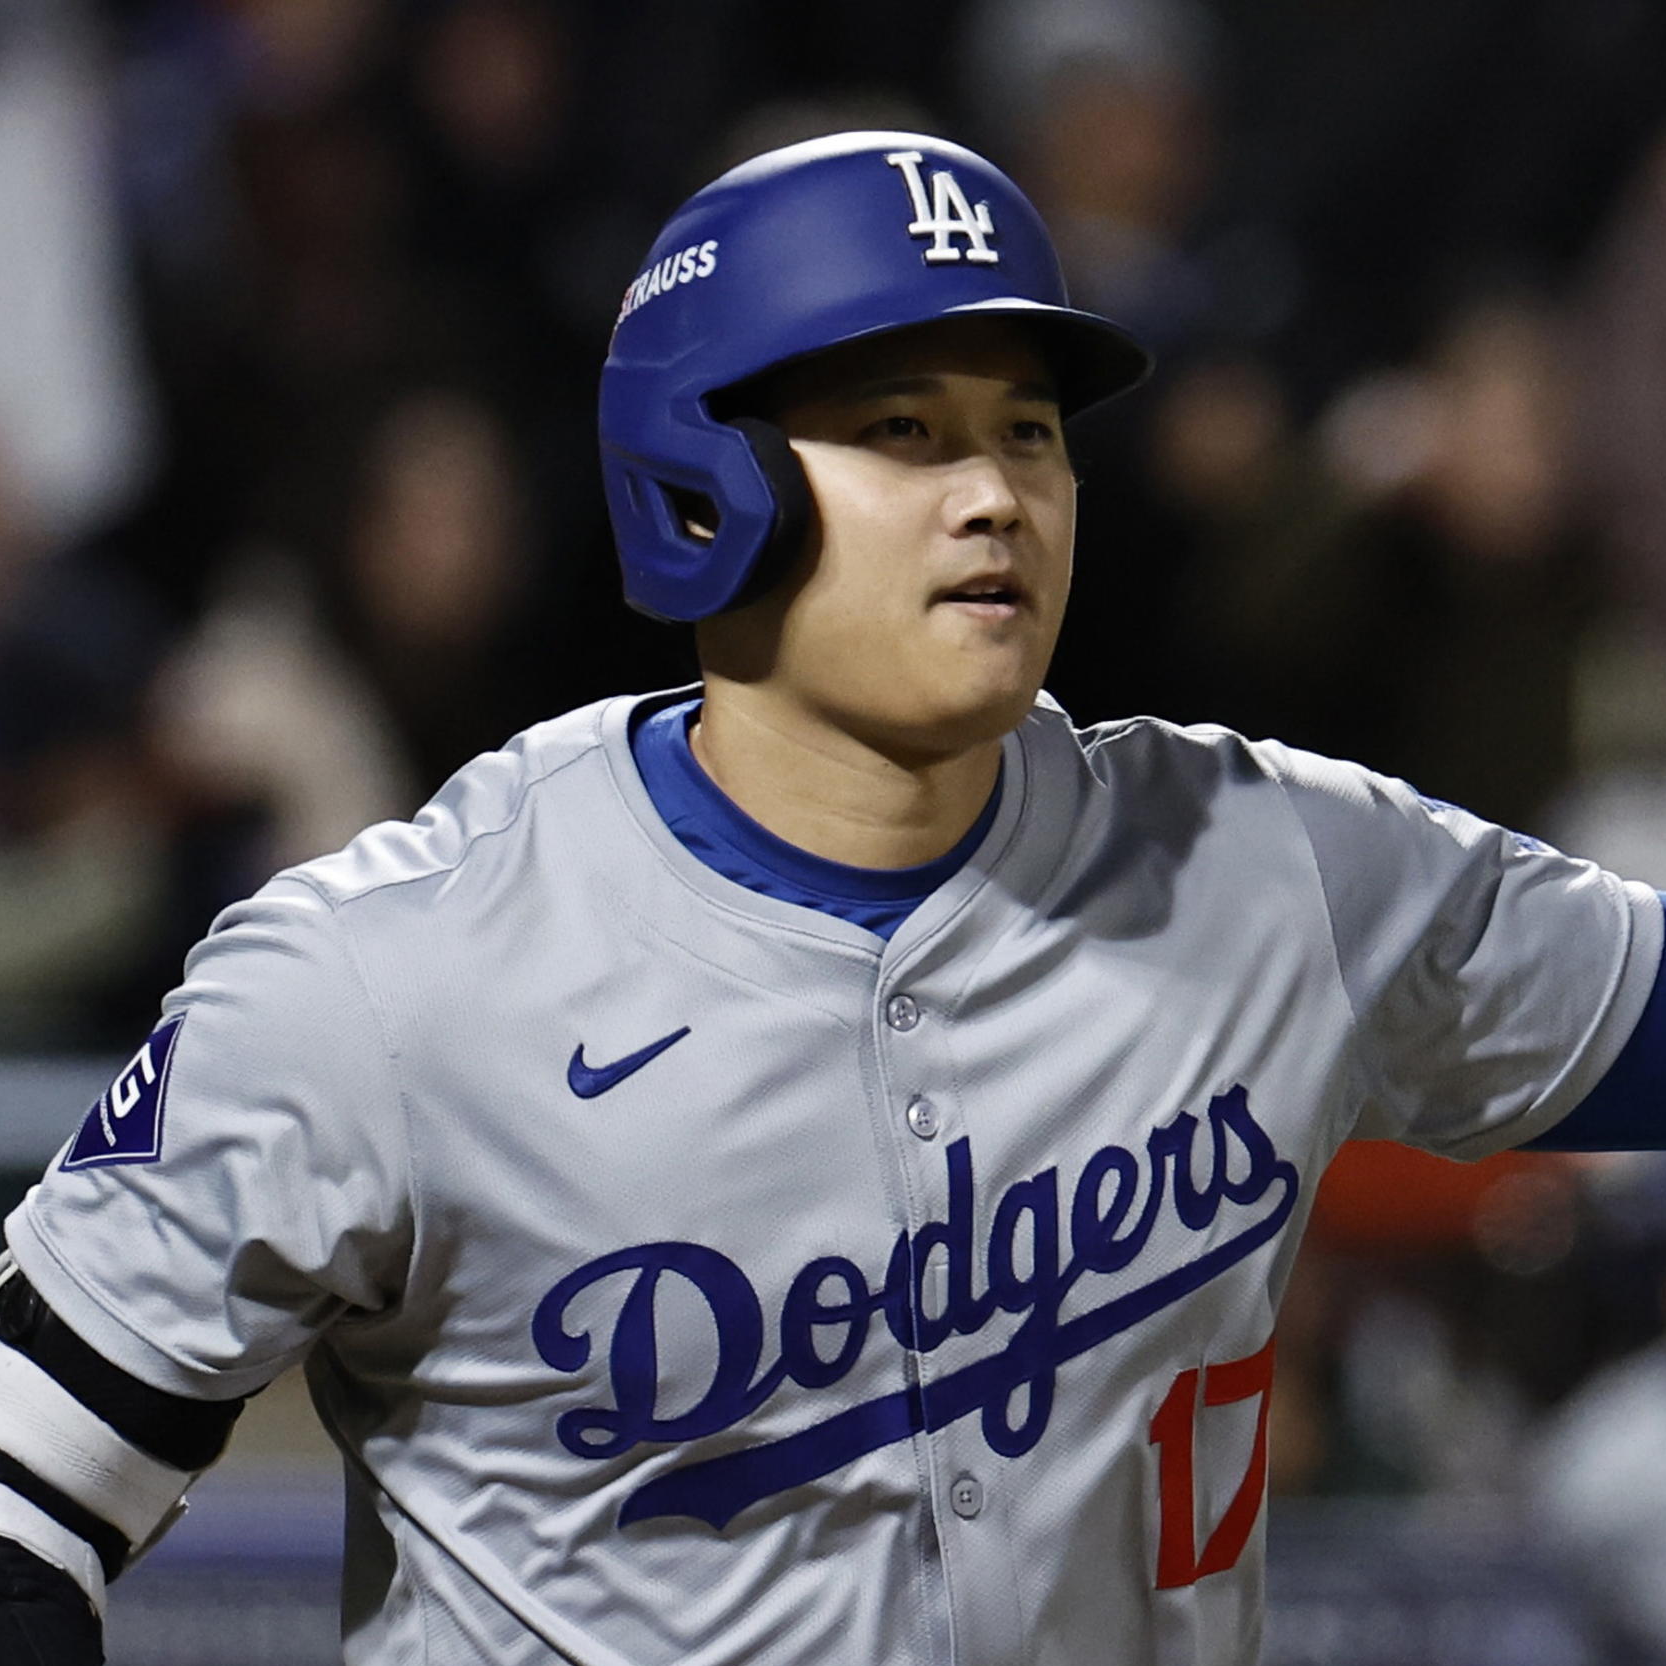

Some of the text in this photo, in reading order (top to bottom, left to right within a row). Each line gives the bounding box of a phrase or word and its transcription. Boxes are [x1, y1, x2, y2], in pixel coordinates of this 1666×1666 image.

[617, 239, 719, 324] TRAUSS
[886, 150, 999, 262] LA
[532, 1082, 1299, 1462] Dodgers
[1149, 1338, 1275, 1591] 17
